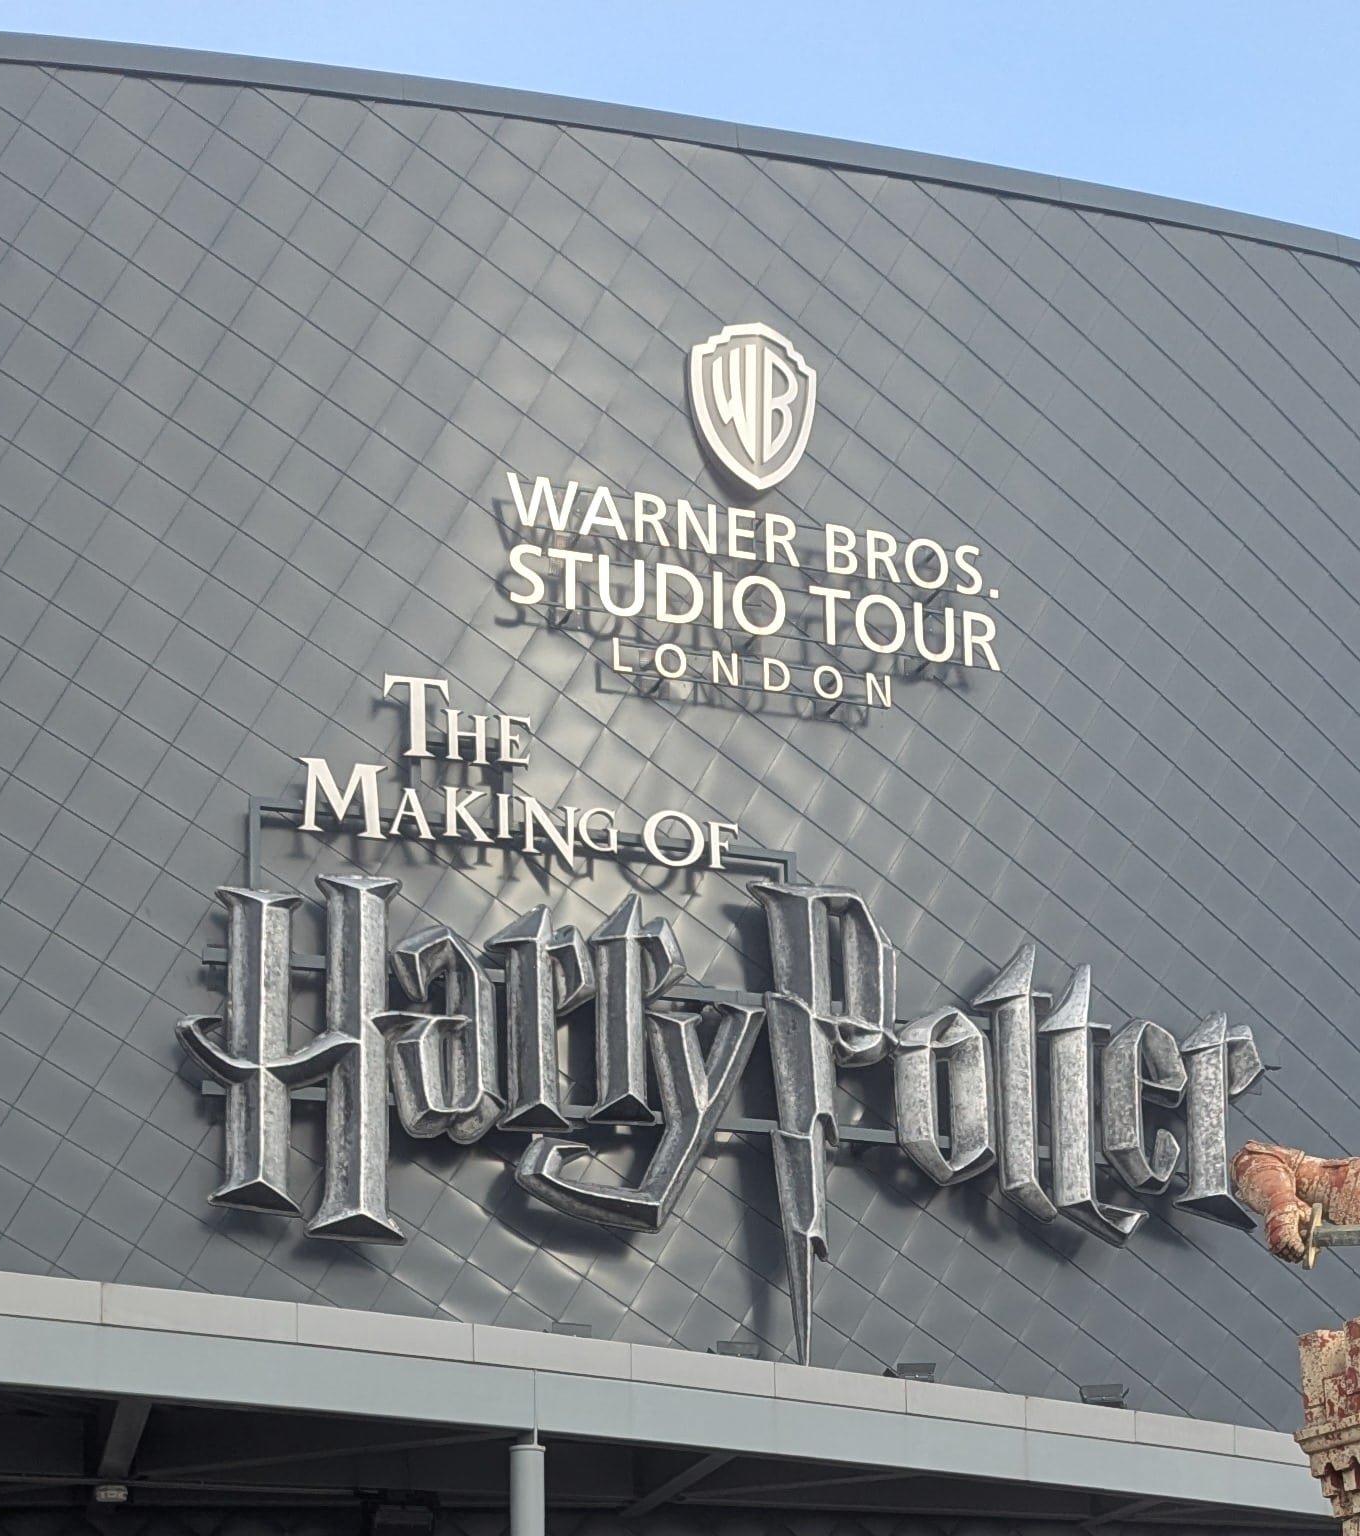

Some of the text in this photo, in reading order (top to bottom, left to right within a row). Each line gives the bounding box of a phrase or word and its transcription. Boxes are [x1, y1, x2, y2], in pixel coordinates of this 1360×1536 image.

[506, 472, 1000, 600] WARNER BROS.
[508, 544, 1001, 672] STUDIO TOUR
[612, 637, 893, 709] LONDON
[174, 873, 1272, 1366] Harry Potter
